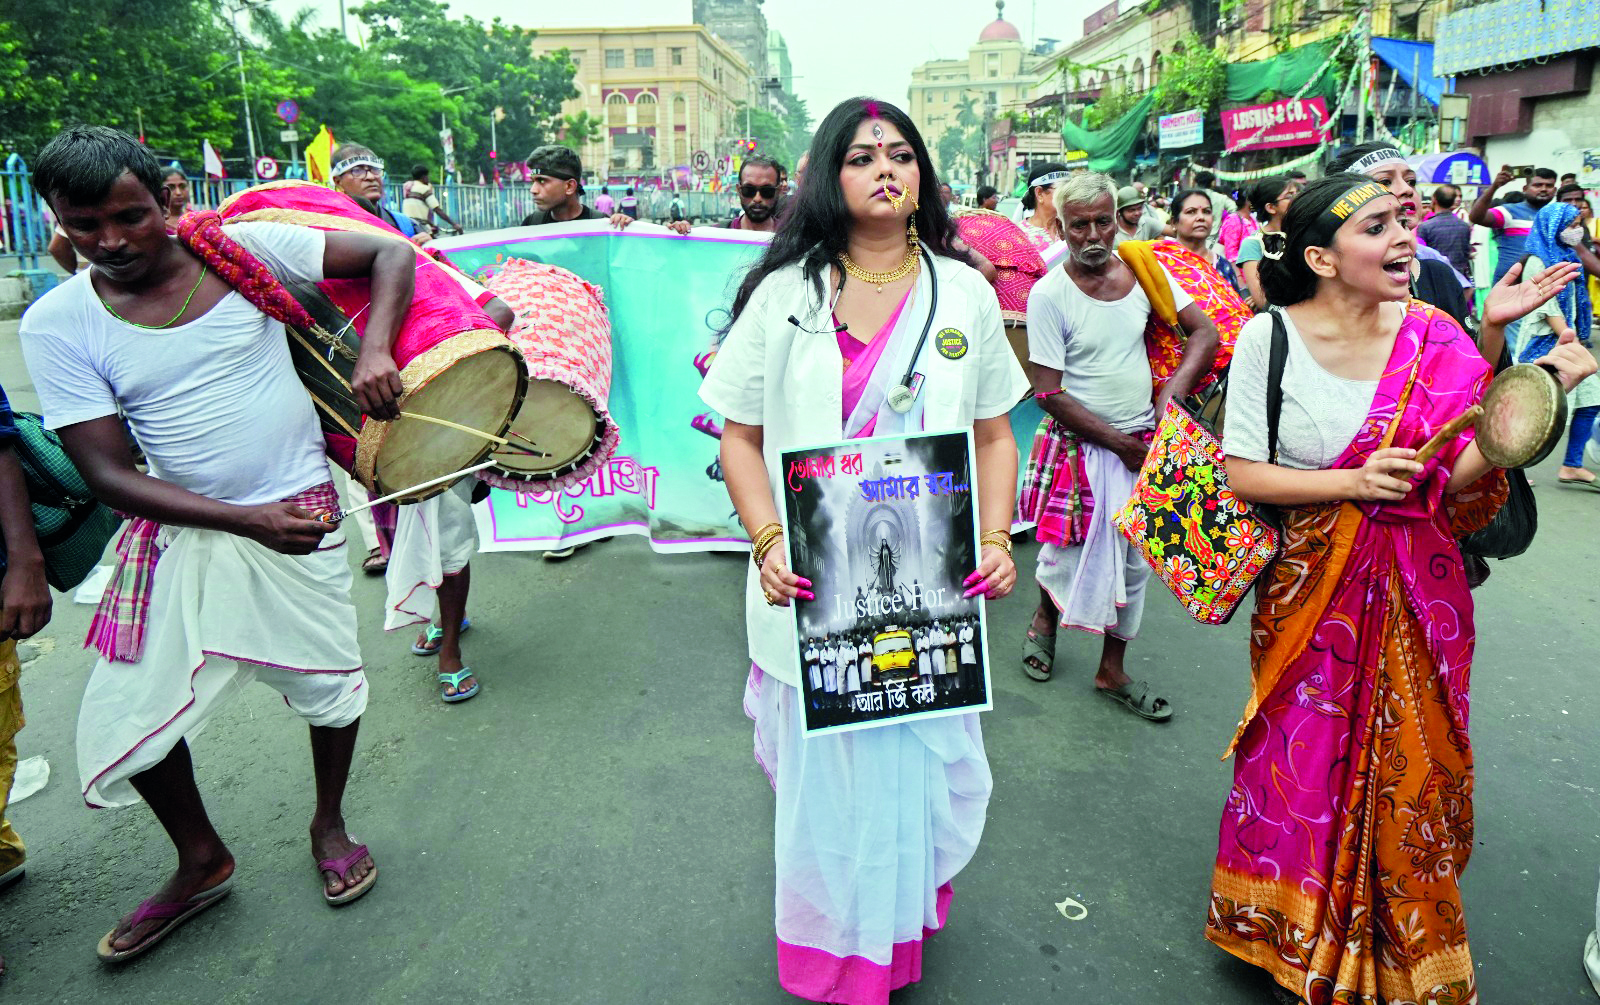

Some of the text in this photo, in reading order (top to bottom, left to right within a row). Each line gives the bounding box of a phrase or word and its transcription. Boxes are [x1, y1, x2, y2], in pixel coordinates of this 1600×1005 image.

[1276, 104, 1285, 124] &
[263, 162, 273, 176] P
[1360, 149, 1405, 168] WE DEMA
[1048, 172, 1056, 180] WE
[1330, 199, 1354, 220] WE
[1345, 183, 1381, 207] WANT
[942, 338, 963, 347] JUSTICE
[787, 452, 863, 492] তোমার স্বর
[858, 475, 920, 502] আমার
[833, 588, 904, 619] Justice
[855, 691, 884, 713] আর
[910, 682, 935, 705] কর
